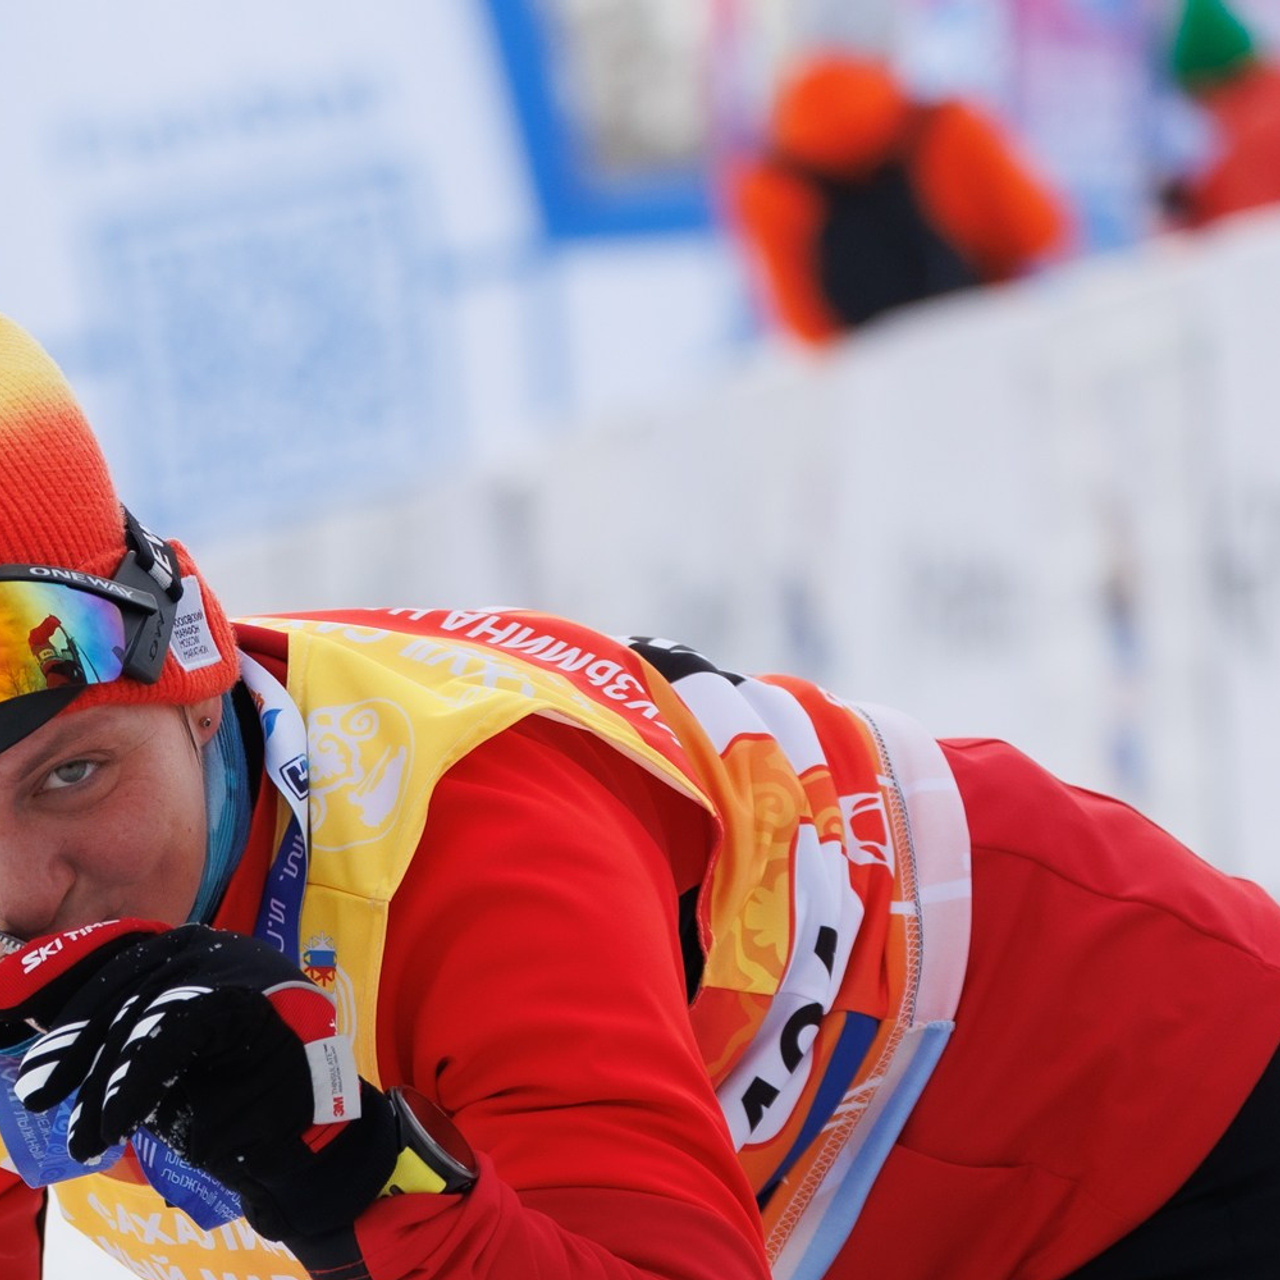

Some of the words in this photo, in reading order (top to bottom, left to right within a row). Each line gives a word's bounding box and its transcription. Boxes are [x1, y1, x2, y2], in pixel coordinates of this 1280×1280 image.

[29, 566, 134, 600] ONEWAY
[440, 609, 682, 748] УЗЬМИНА
[21, 937, 64, 975] SKI
[63, 919, 120, 942] TIM
[333, 1096, 345, 1117] 3M
[161, 1168, 218, 1207] ЛЫЖНЫЙ
